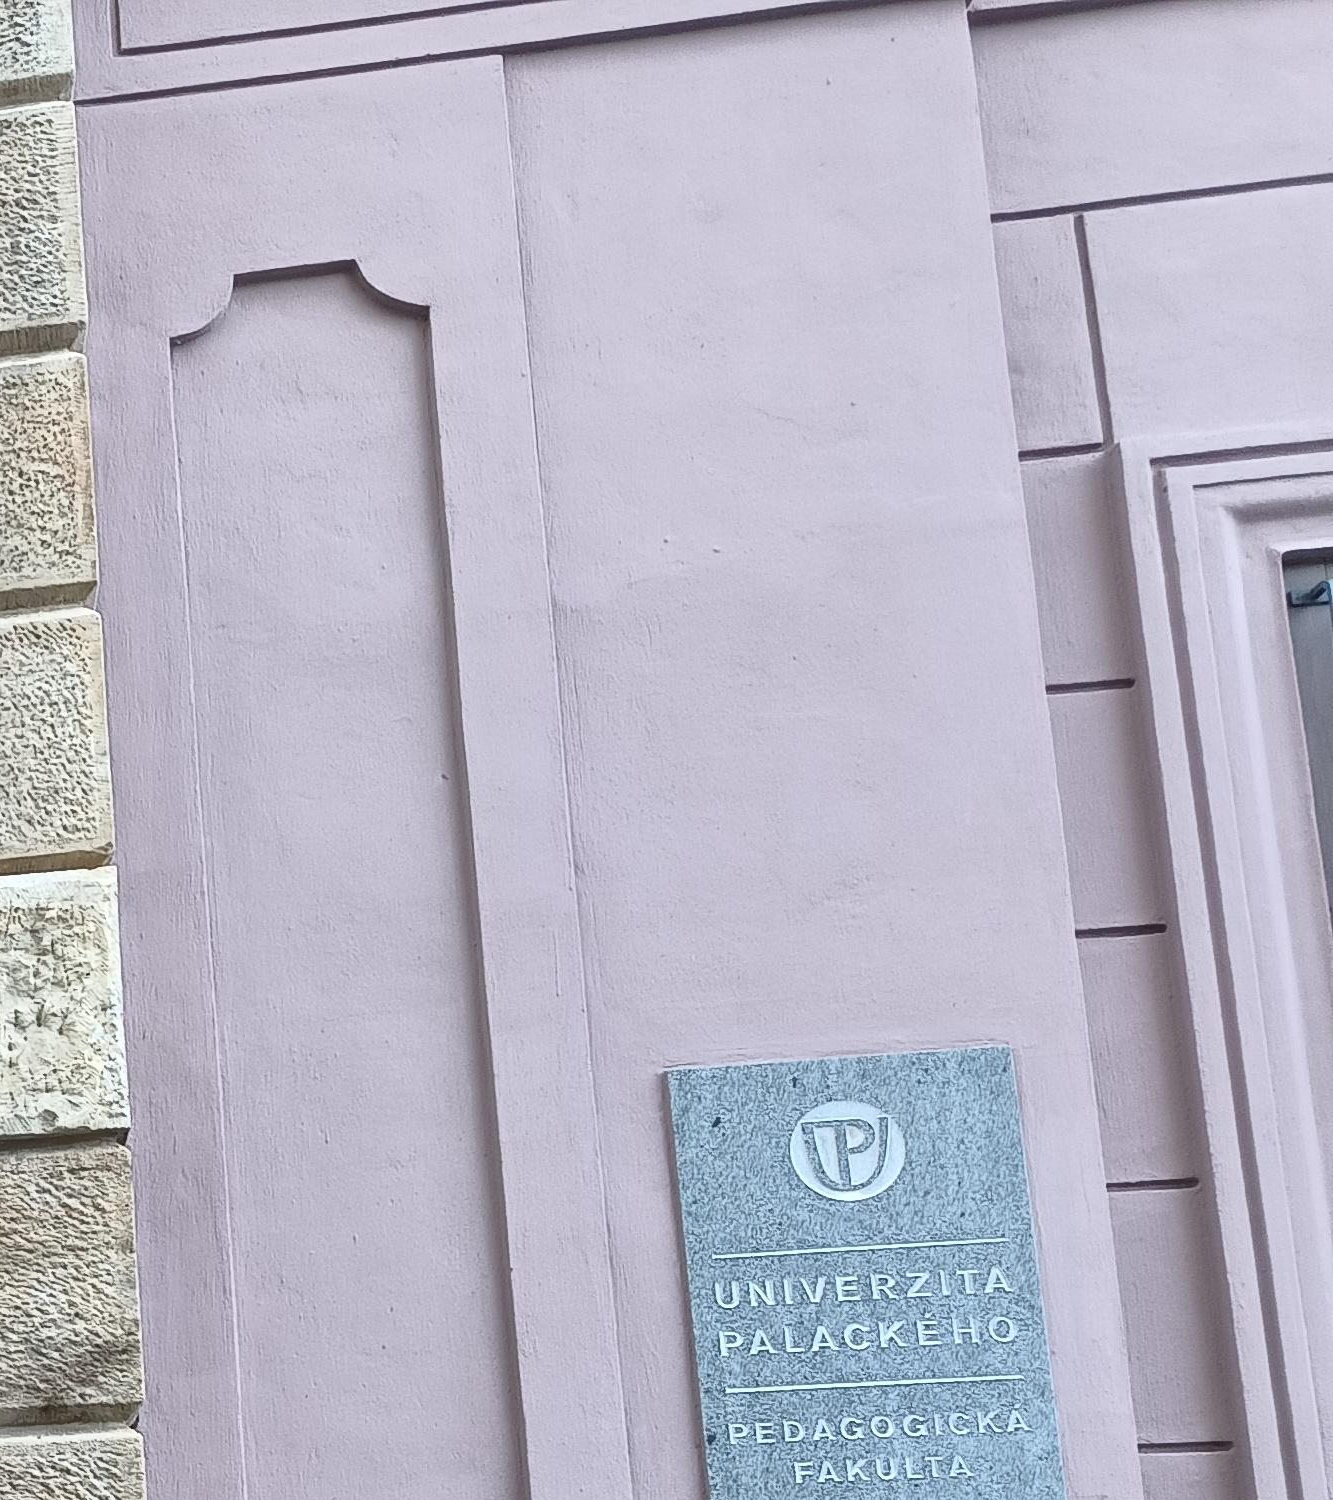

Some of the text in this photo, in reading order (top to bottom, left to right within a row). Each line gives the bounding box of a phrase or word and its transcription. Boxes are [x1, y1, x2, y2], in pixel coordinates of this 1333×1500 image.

[714, 1266, 1014, 1309] UNIVERZITA
[718, 1312, 1019, 1357] PALACKÉHO
[728, 1403, 1032, 1444] PEDAGOGICKÁ
[793, 1454, 975, 1484] FAKULTA
